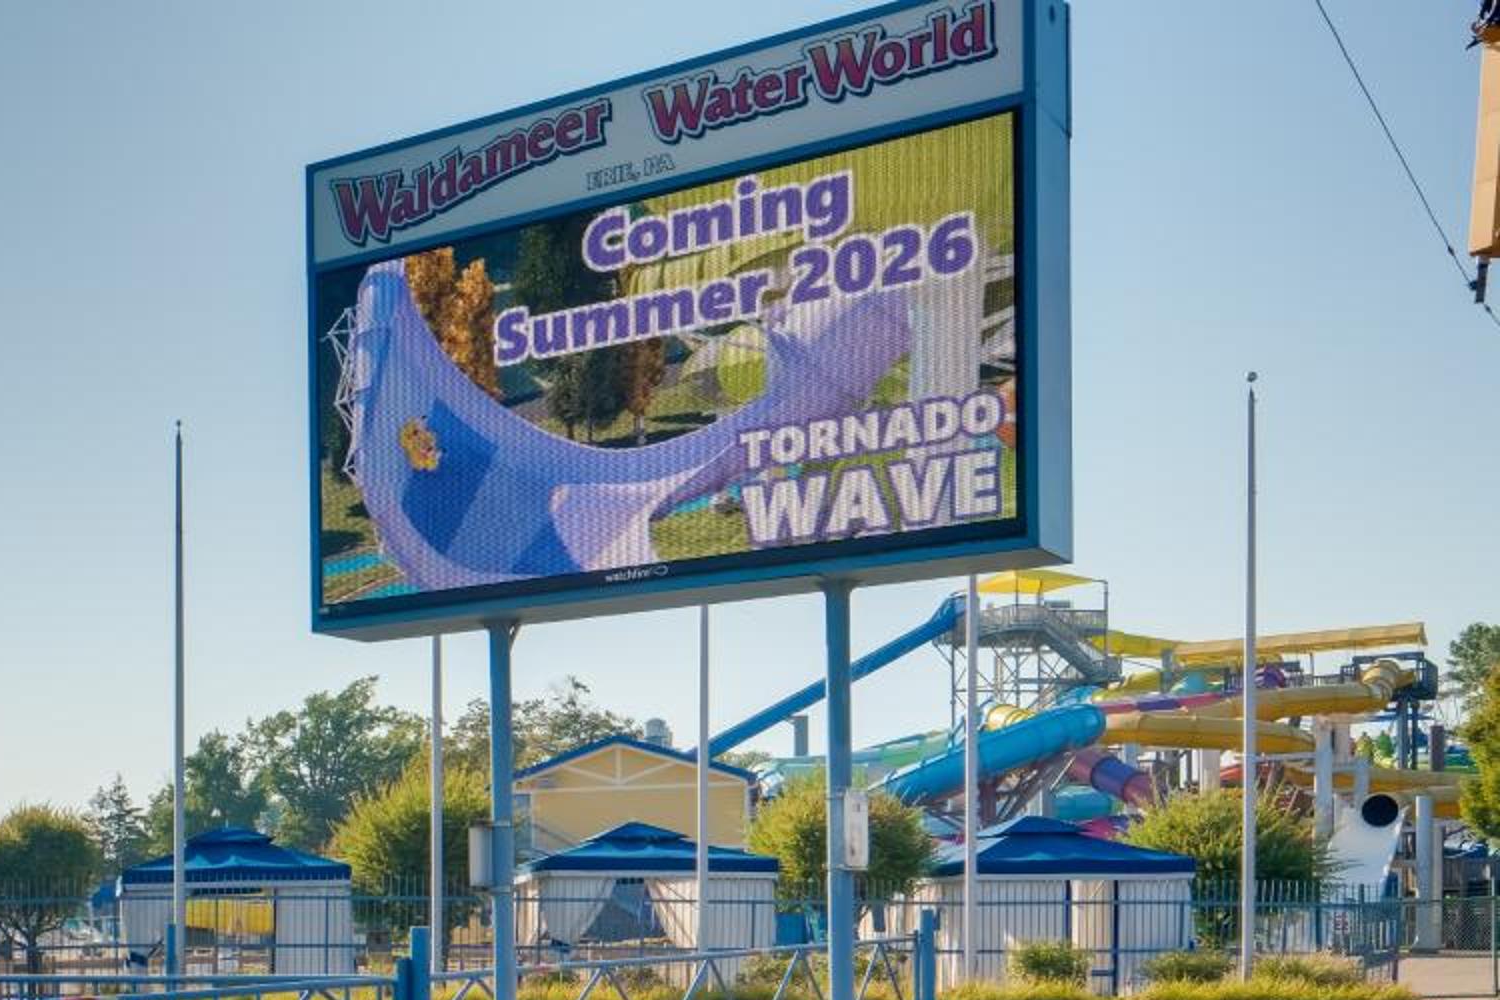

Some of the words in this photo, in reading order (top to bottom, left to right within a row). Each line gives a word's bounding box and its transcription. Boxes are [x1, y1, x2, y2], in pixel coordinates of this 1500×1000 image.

[334, 99, 610, 244] Waldameer
[584, 170, 852, 271] Coming
[495, 270, 769, 365] Summer
[788, 212, 974, 305] 2026
[739, 394, 1001, 469] TORNADO
[742, 449, 998, 542] WAVE
